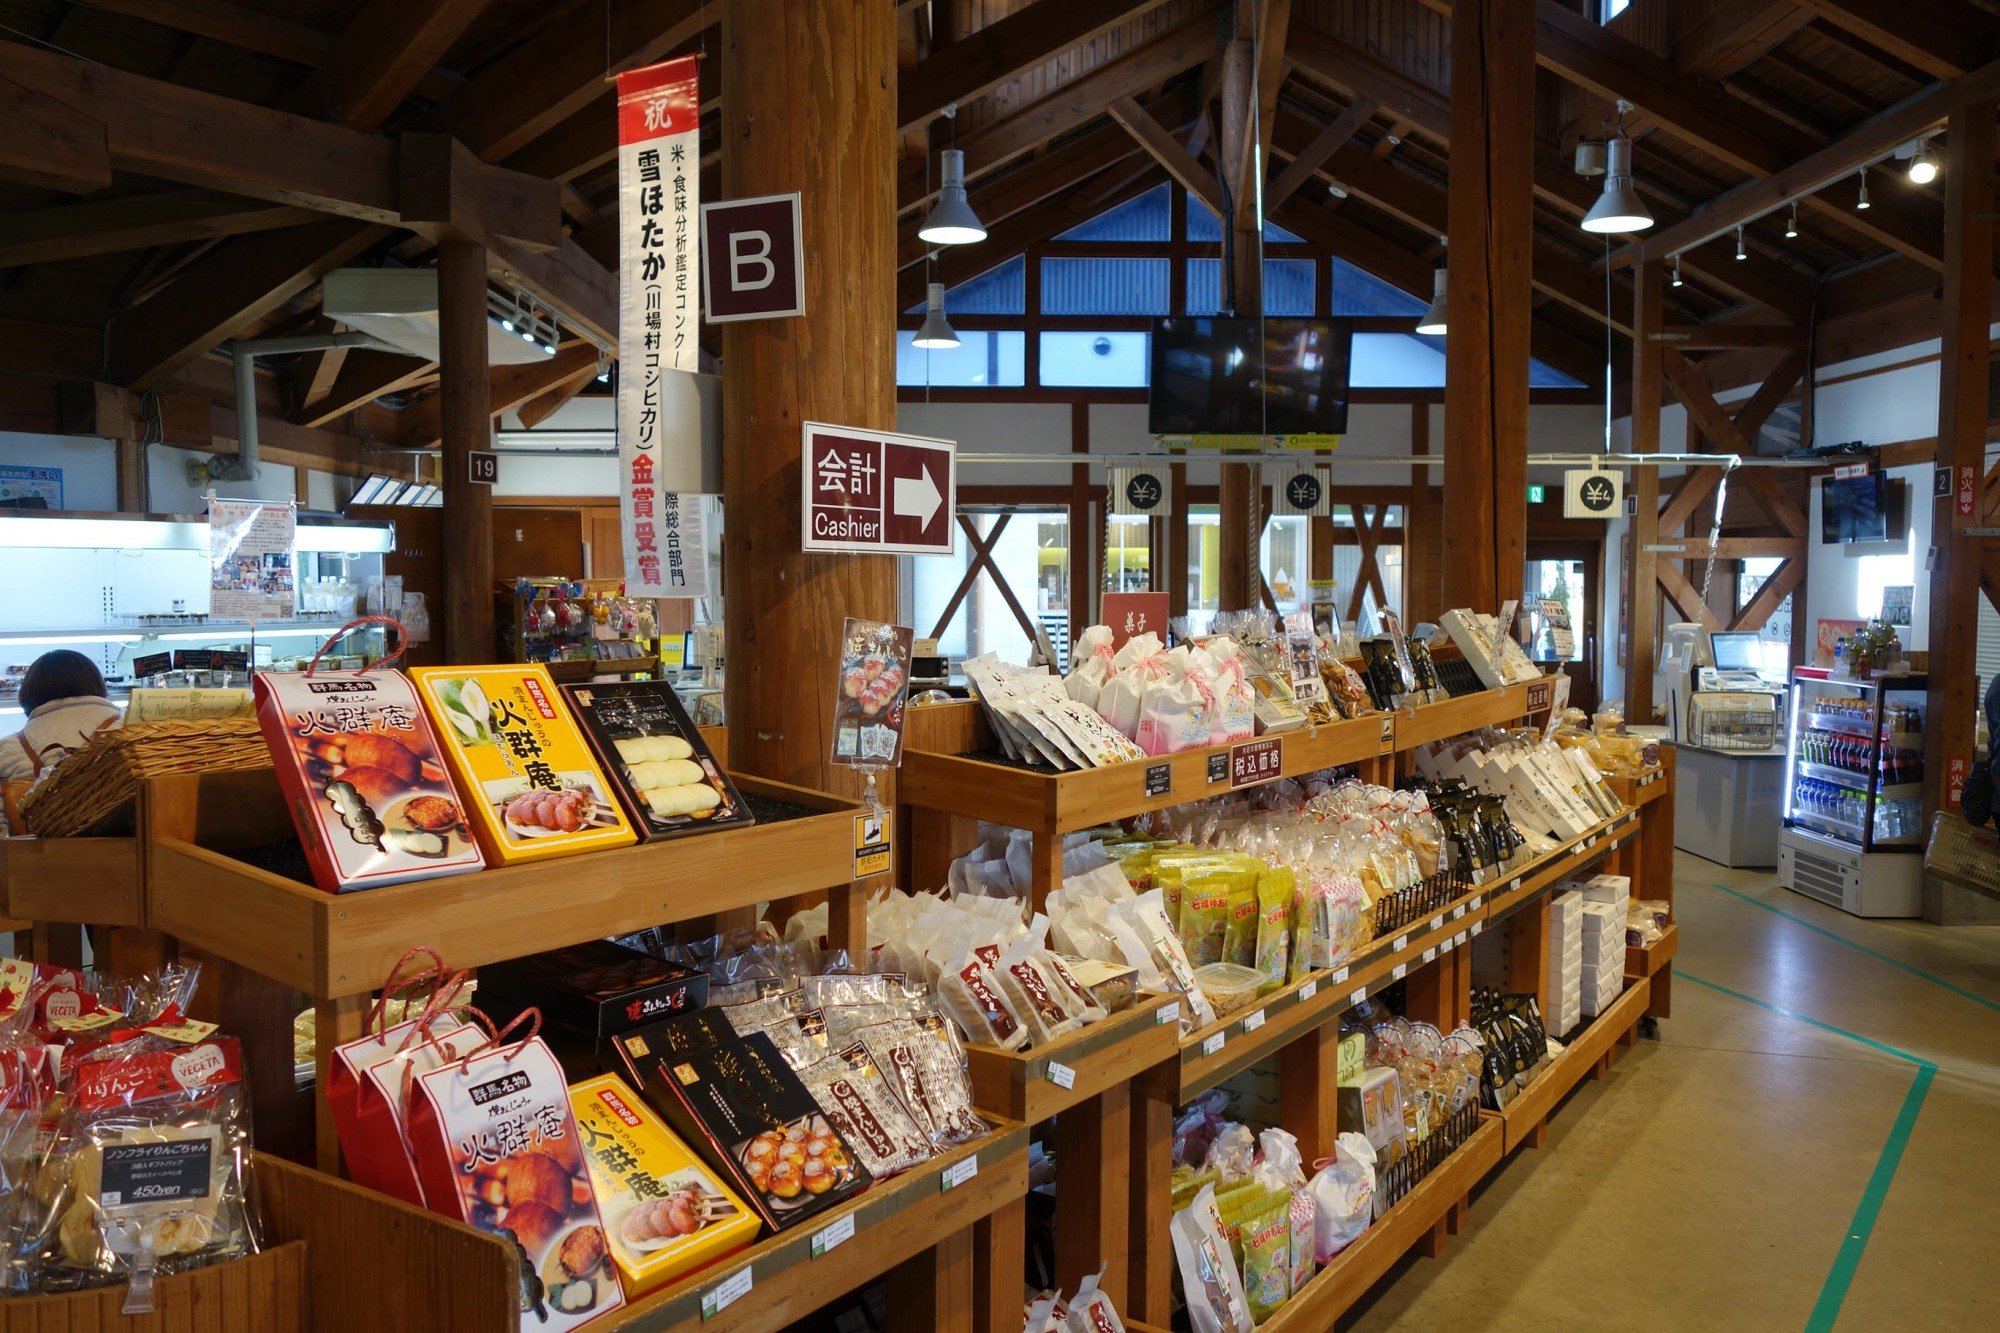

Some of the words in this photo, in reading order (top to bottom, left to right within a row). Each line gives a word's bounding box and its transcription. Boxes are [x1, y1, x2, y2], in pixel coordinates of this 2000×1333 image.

[644, 98, 672, 131] 祝
[670, 145, 687, 368] 米・食味分析鑑定コンクー
[729, 230, 775, 292] B
[475, 459, 494, 477] 19
[817, 448, 876, 495] 会計
[1939, 477, 1945, 488] 2
[1961, 467, 1974, 502] 消火器
[815, 512, 879, 538] Cashier
[664, 492, 686, 587] 際総合部門
[1124, 611, 1147, 633] 菓子
[310, 682, 374, 693] 群馬名物
[297, 704, 415, 736] 火群庵
[491, 698, 563, 793] 火群庵
[1235, 749, 1279, 776] 税込価格
[1192, 898, 1227, 910] 七福神あ
[50, 1005, 77, 1016] VEGETA
[178, 1057, 221, 1077] VEGETA
[471, 1075, 529, 1102] 群馬名物
[462, 1104, 564, 1172] 火群庵
[843, 1095, 893, 1158] 焼まんじゅう
[106, 1143, 209, 1160] ノンフライりんごちゃん
[577, 1119, 671, 1202] 火群庵
[132, 1184, 180, 1198] 450yen
